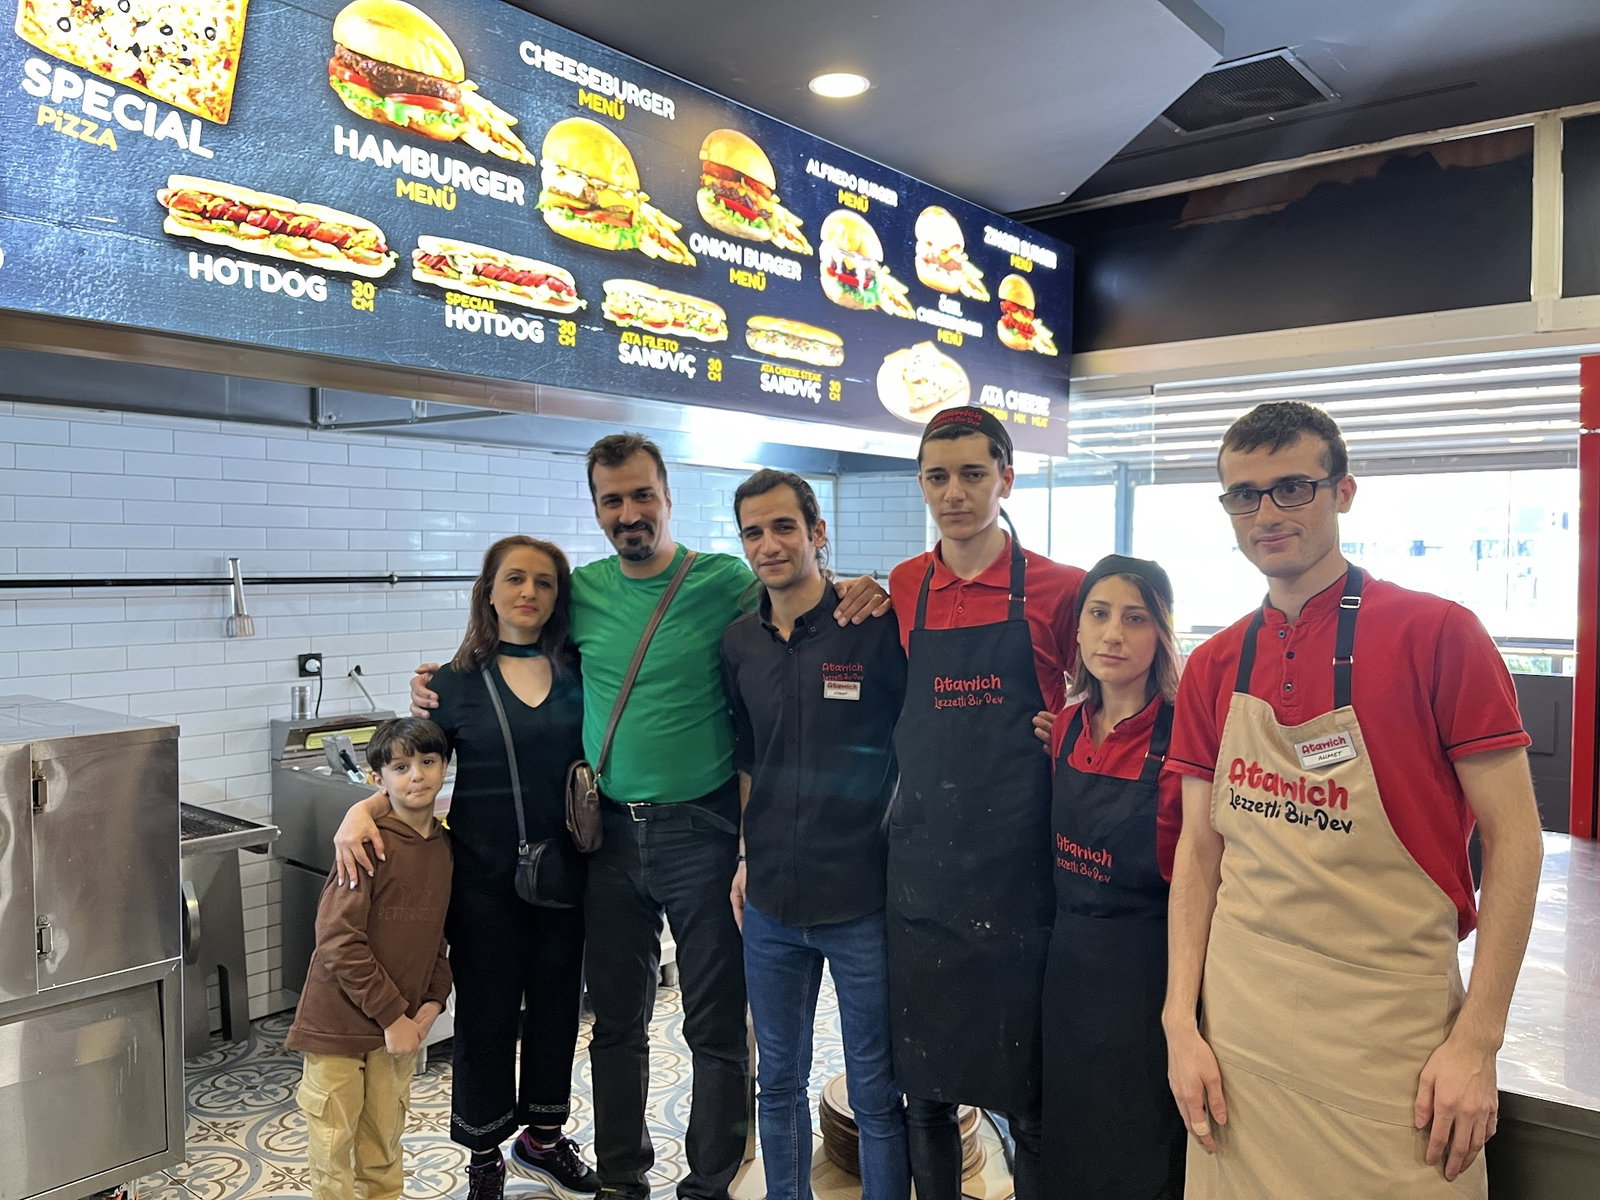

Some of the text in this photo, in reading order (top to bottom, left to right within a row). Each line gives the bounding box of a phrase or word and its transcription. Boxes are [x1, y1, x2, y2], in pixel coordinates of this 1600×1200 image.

[519, 41, 676, 120] CHEESEBURGER
[22, 58, 214, 159] SPECIAL
[578, 89, 625, 120] MENÜ
[334, 125, 525, 206] HAMBURGER
[396, 178, 457, 210] MENÜ
[838, 189, 869, 213] MENÜ
[689, 232, 802, 281] ONION BURGER
[189, 252, 327, 301] HOTDOG
[729, 267, 766, 291] MENÜ
[352, 280, 375, 299] 30
[352, 298, 375, 312] CM
[445, 291, 498, 314] SPECIAL
[445, 305, 545, 344] HOTDOG
[558, 319, 577, 337] 30
[558, 334, 576, 347] CM
[621, 331, 641, 346] ATA
[707, 357, 723, 373] 30
[829, 380, 842, 393] 30
[822, 662, 863, 672] Atawich
[934, 673, 1001, 693] Atawich
[967, 693, 983, 706] Bir
[983, 692, 1003, 705] Dev
[1301, 736, 1346, 754] Atawich
[1228, 758, 1349, 811] Atawich
[1229, 788, 1353, 834] Lezzetli Bir Dev
[1056, 832, 1113, 869] Atawich
